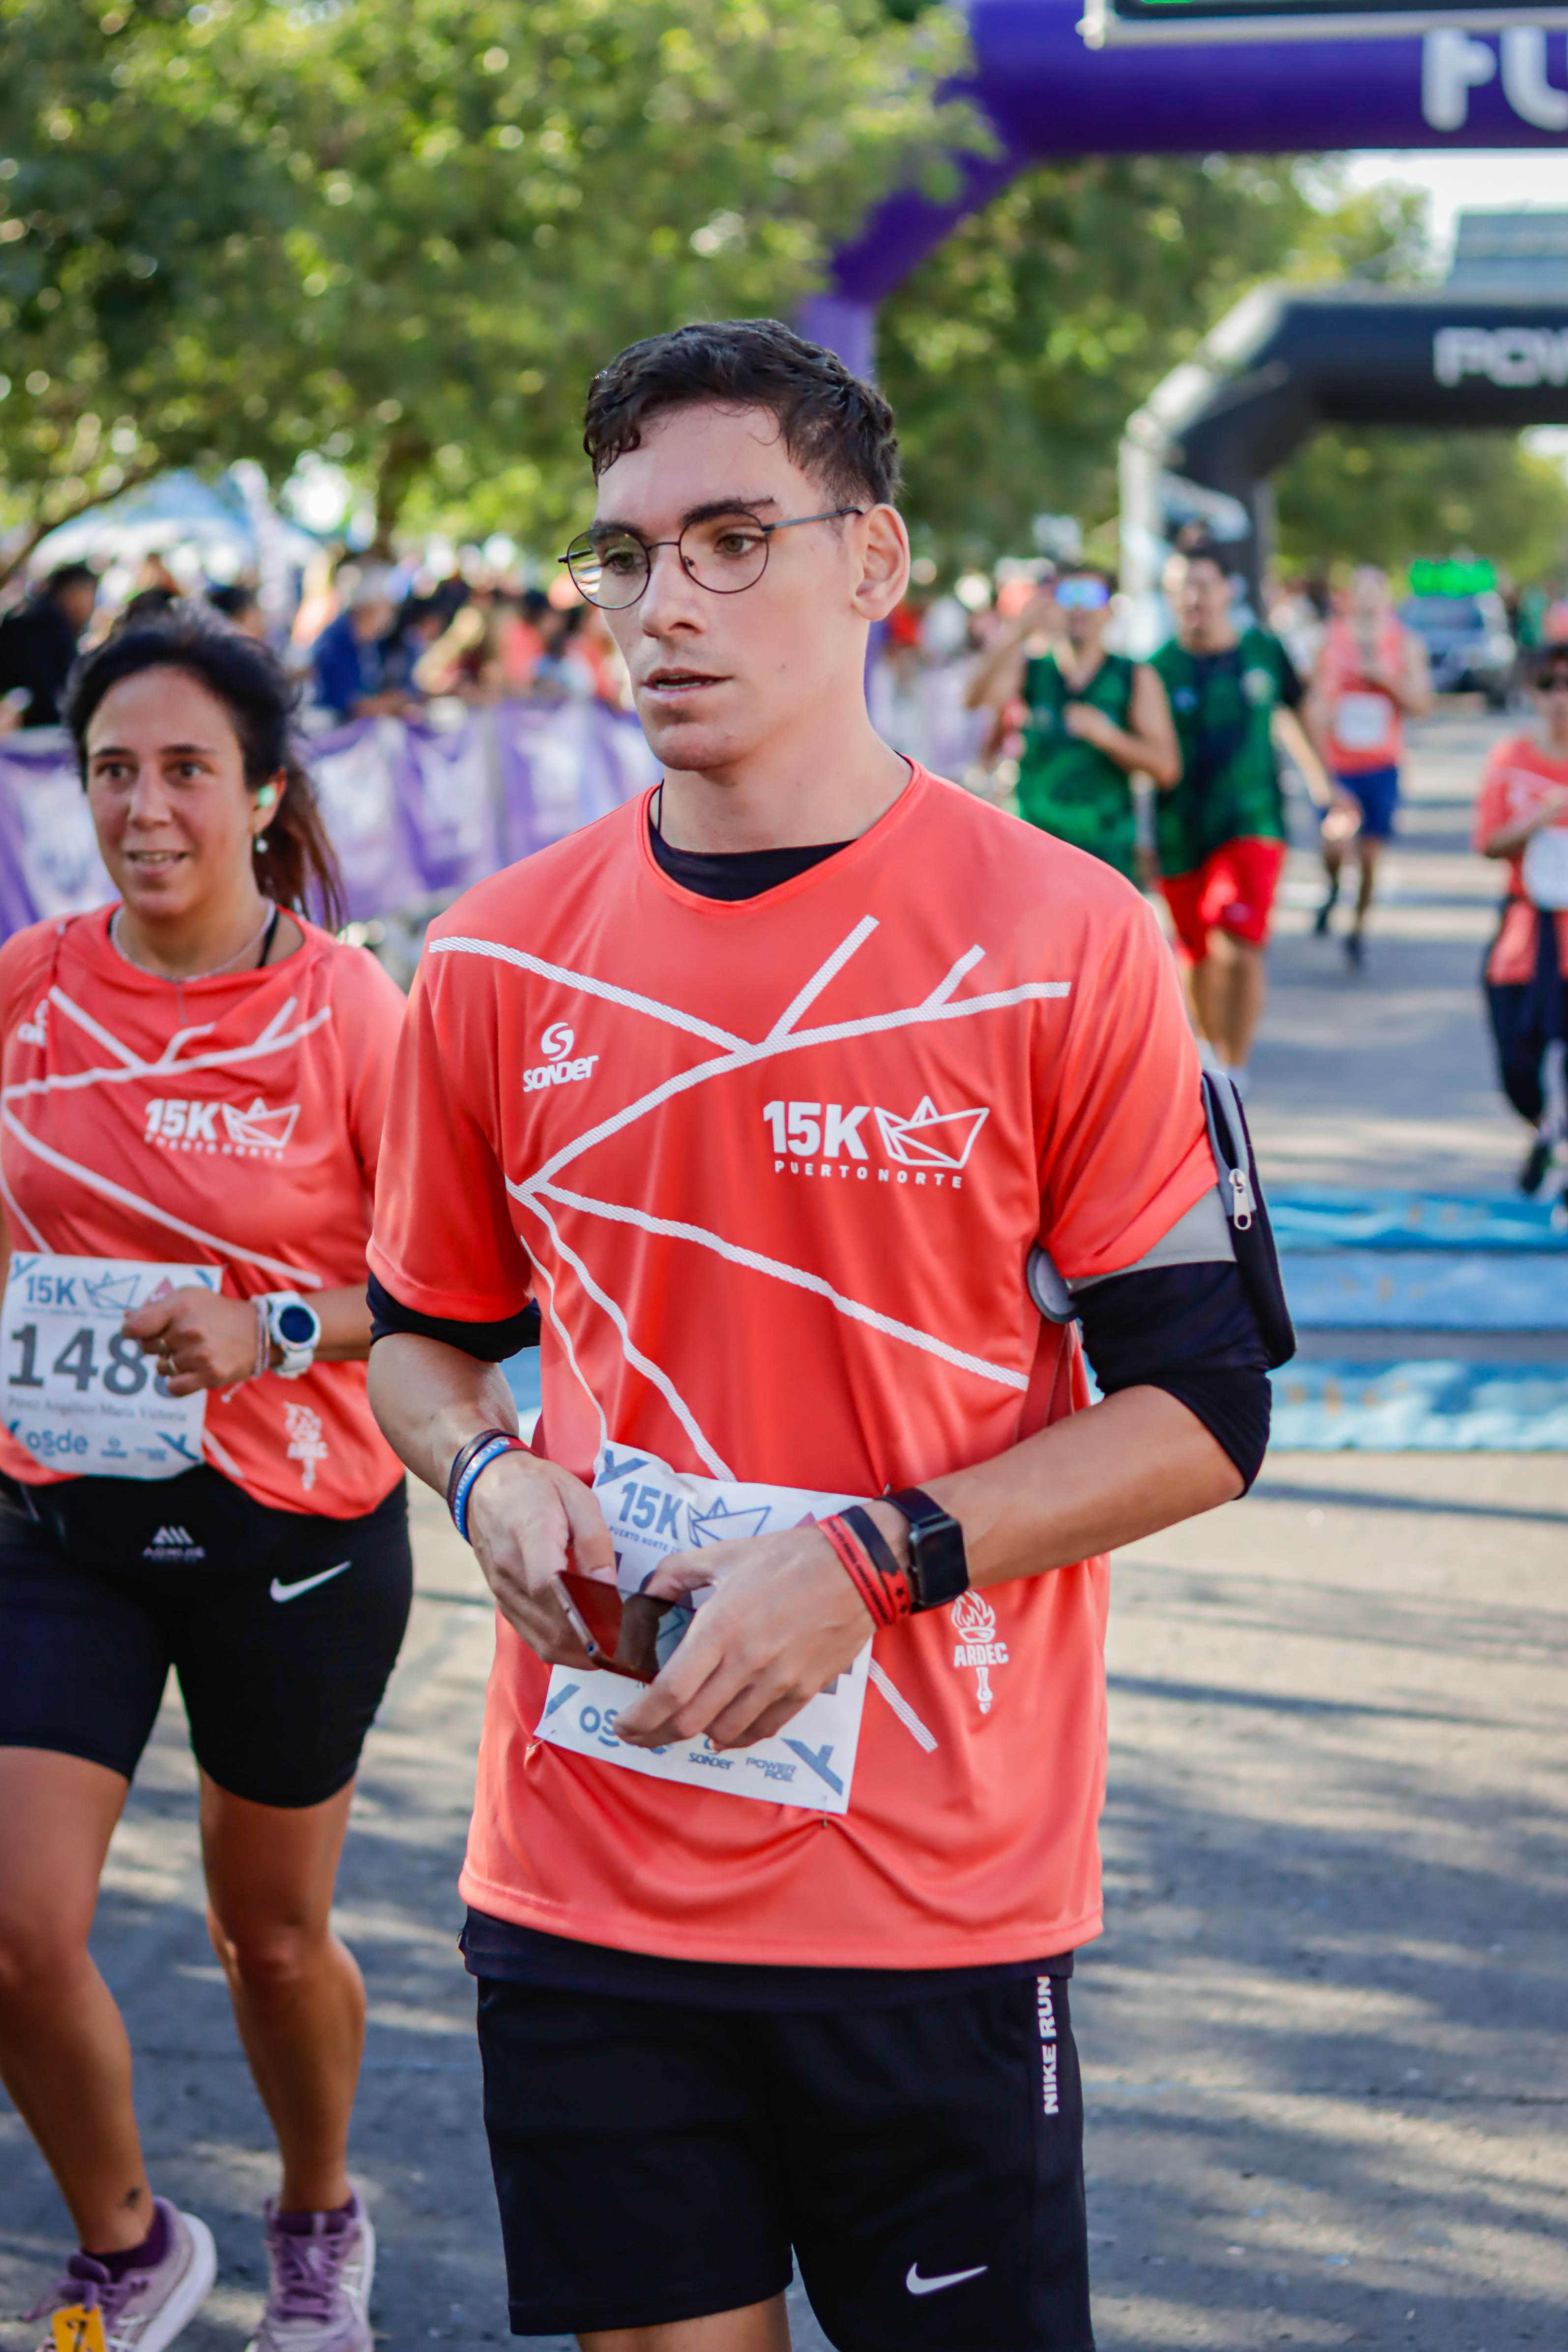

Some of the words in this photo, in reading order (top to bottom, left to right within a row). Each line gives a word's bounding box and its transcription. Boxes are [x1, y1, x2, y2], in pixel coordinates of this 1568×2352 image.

[146, 1098, 220, 1141] 15K
[763, 1101, 870, 1160] 15K
[774, 1160, 867, 1179] PUERTO
[878, 1169, 962, 1188] NORTE
[26, 1275, 77, 1306] 15K
[619, 1481, 683, 1540] 15K
[954, 1642, 1009, 1668] ARDEC
[1037, 1976, 1057, 2038] RUN
[1042, 2044, 1059, 2115] NIKE
